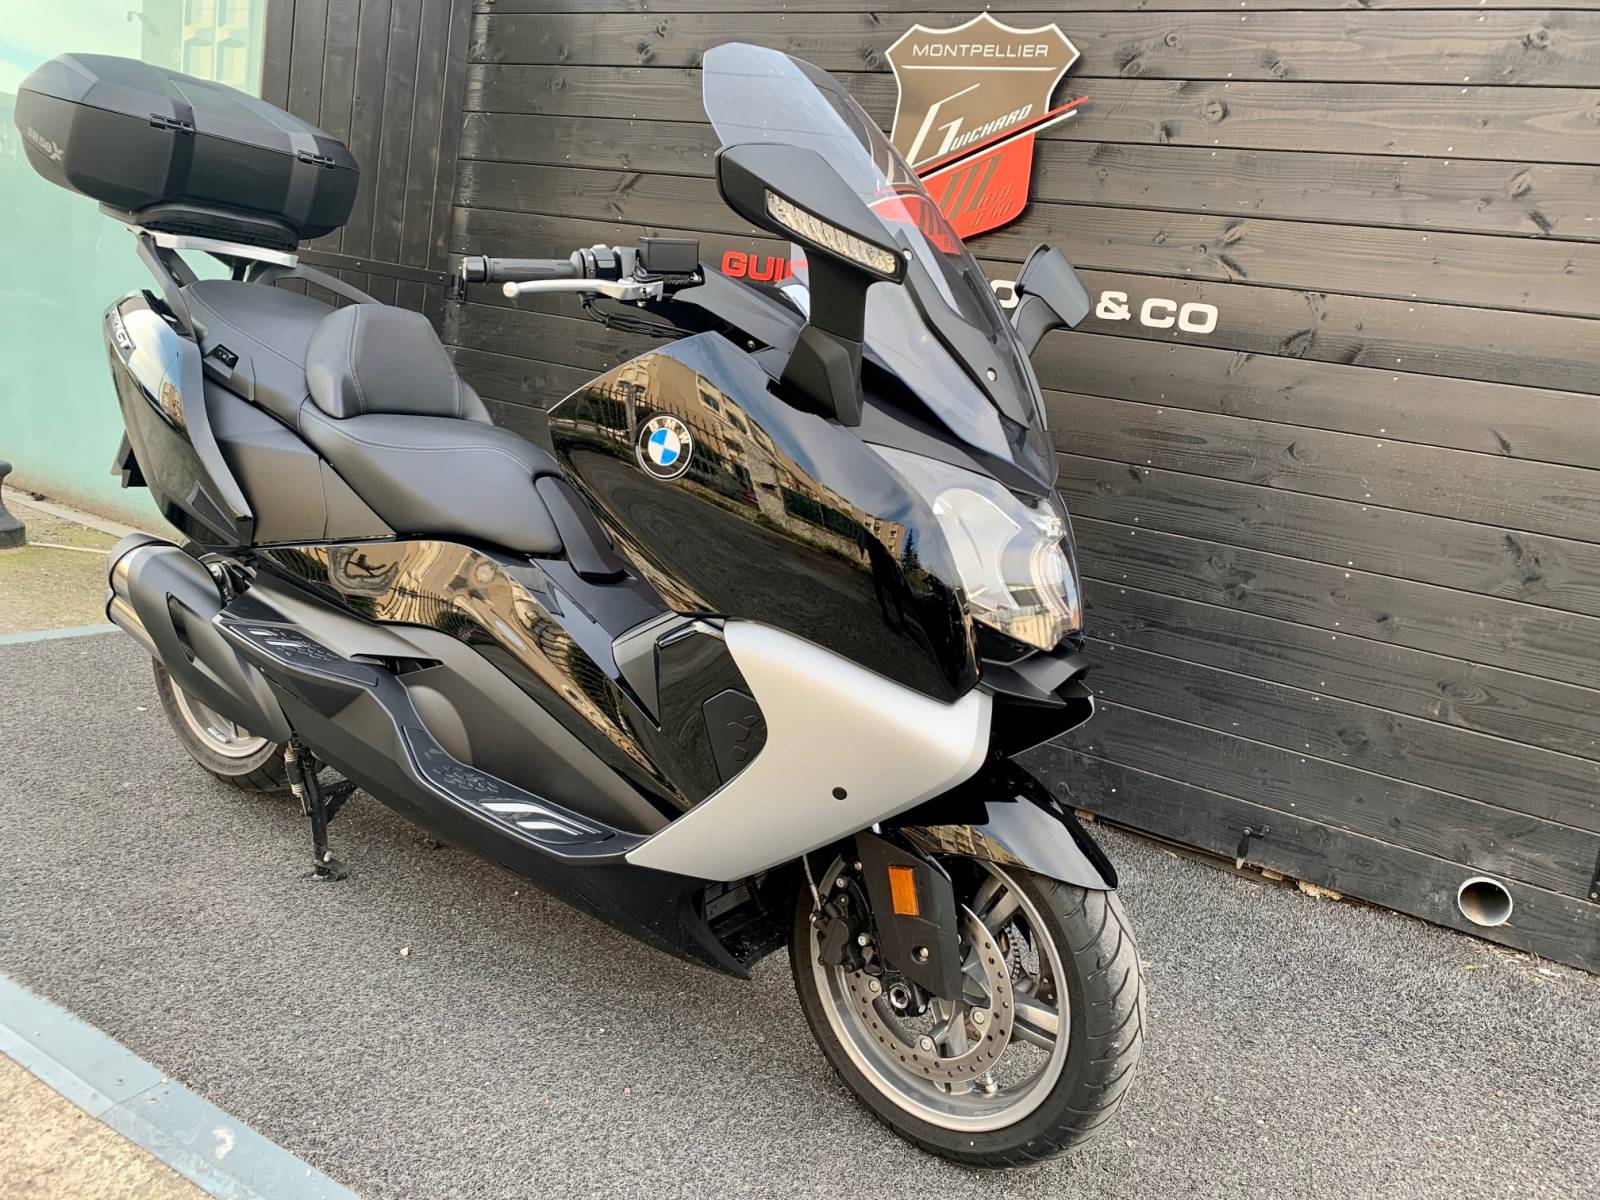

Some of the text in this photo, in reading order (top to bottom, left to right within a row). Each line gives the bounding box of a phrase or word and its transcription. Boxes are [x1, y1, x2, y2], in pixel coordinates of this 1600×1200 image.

[912, 44, 1048, 58] MONTPELLIER
[905, 83, 1033, 168] GUICHARD
[1096, 291, 1131, 320] &
[1140, 298, 1218, 334] CO
[648, 418, 689, 444] BMW
